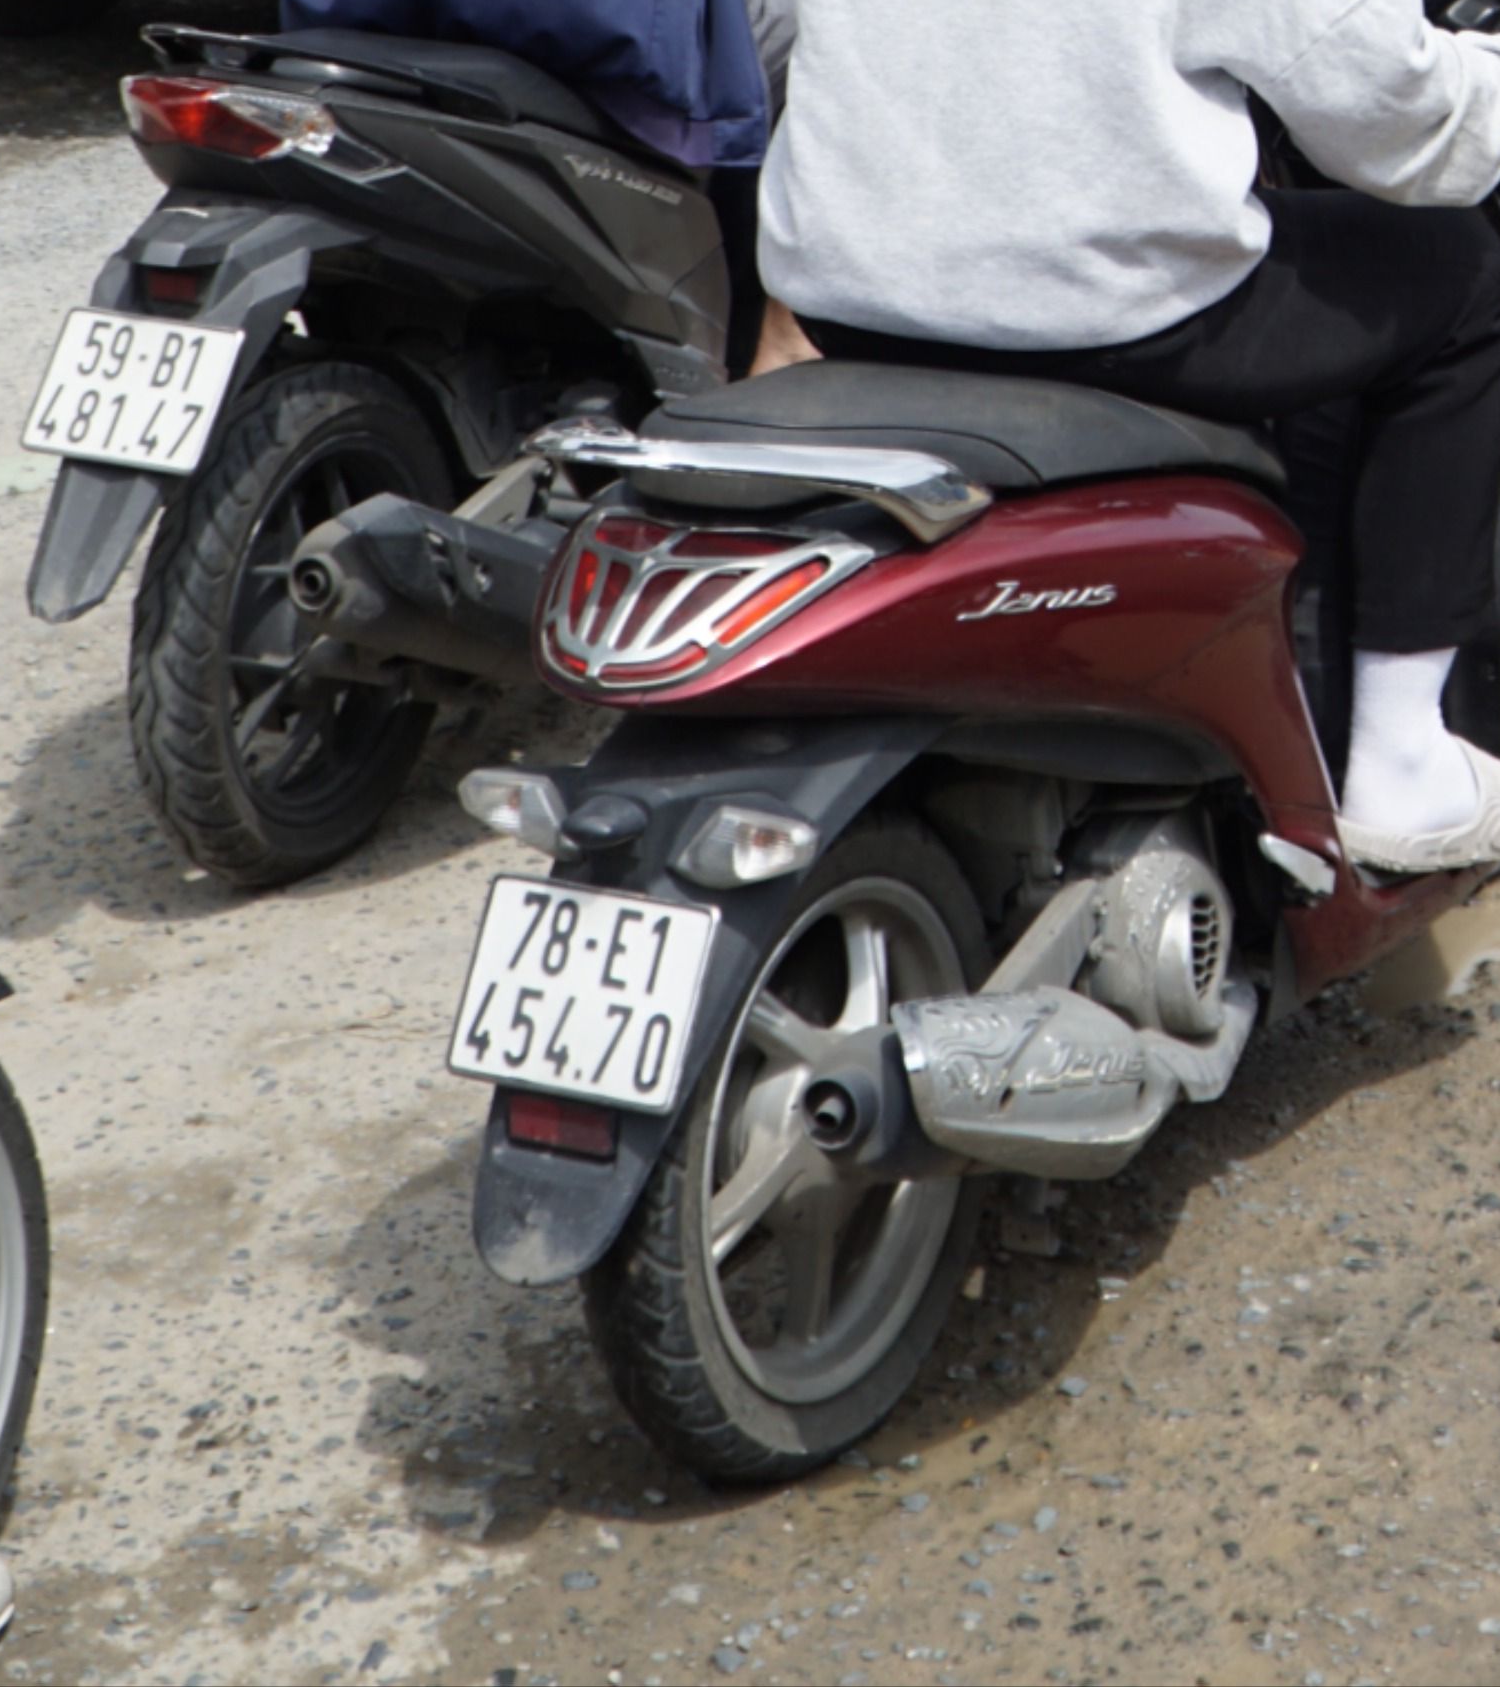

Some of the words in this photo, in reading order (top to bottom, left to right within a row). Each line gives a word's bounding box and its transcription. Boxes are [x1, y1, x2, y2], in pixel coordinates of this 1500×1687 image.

[76, 320, 207, 393] 59-B1
[36, 383, 205, 460] 481.47
[956, 579, 1117, 622] Janus
[507, 891, 672, 996] 78-E1
[465, 981, 672, 1095] 454.70
